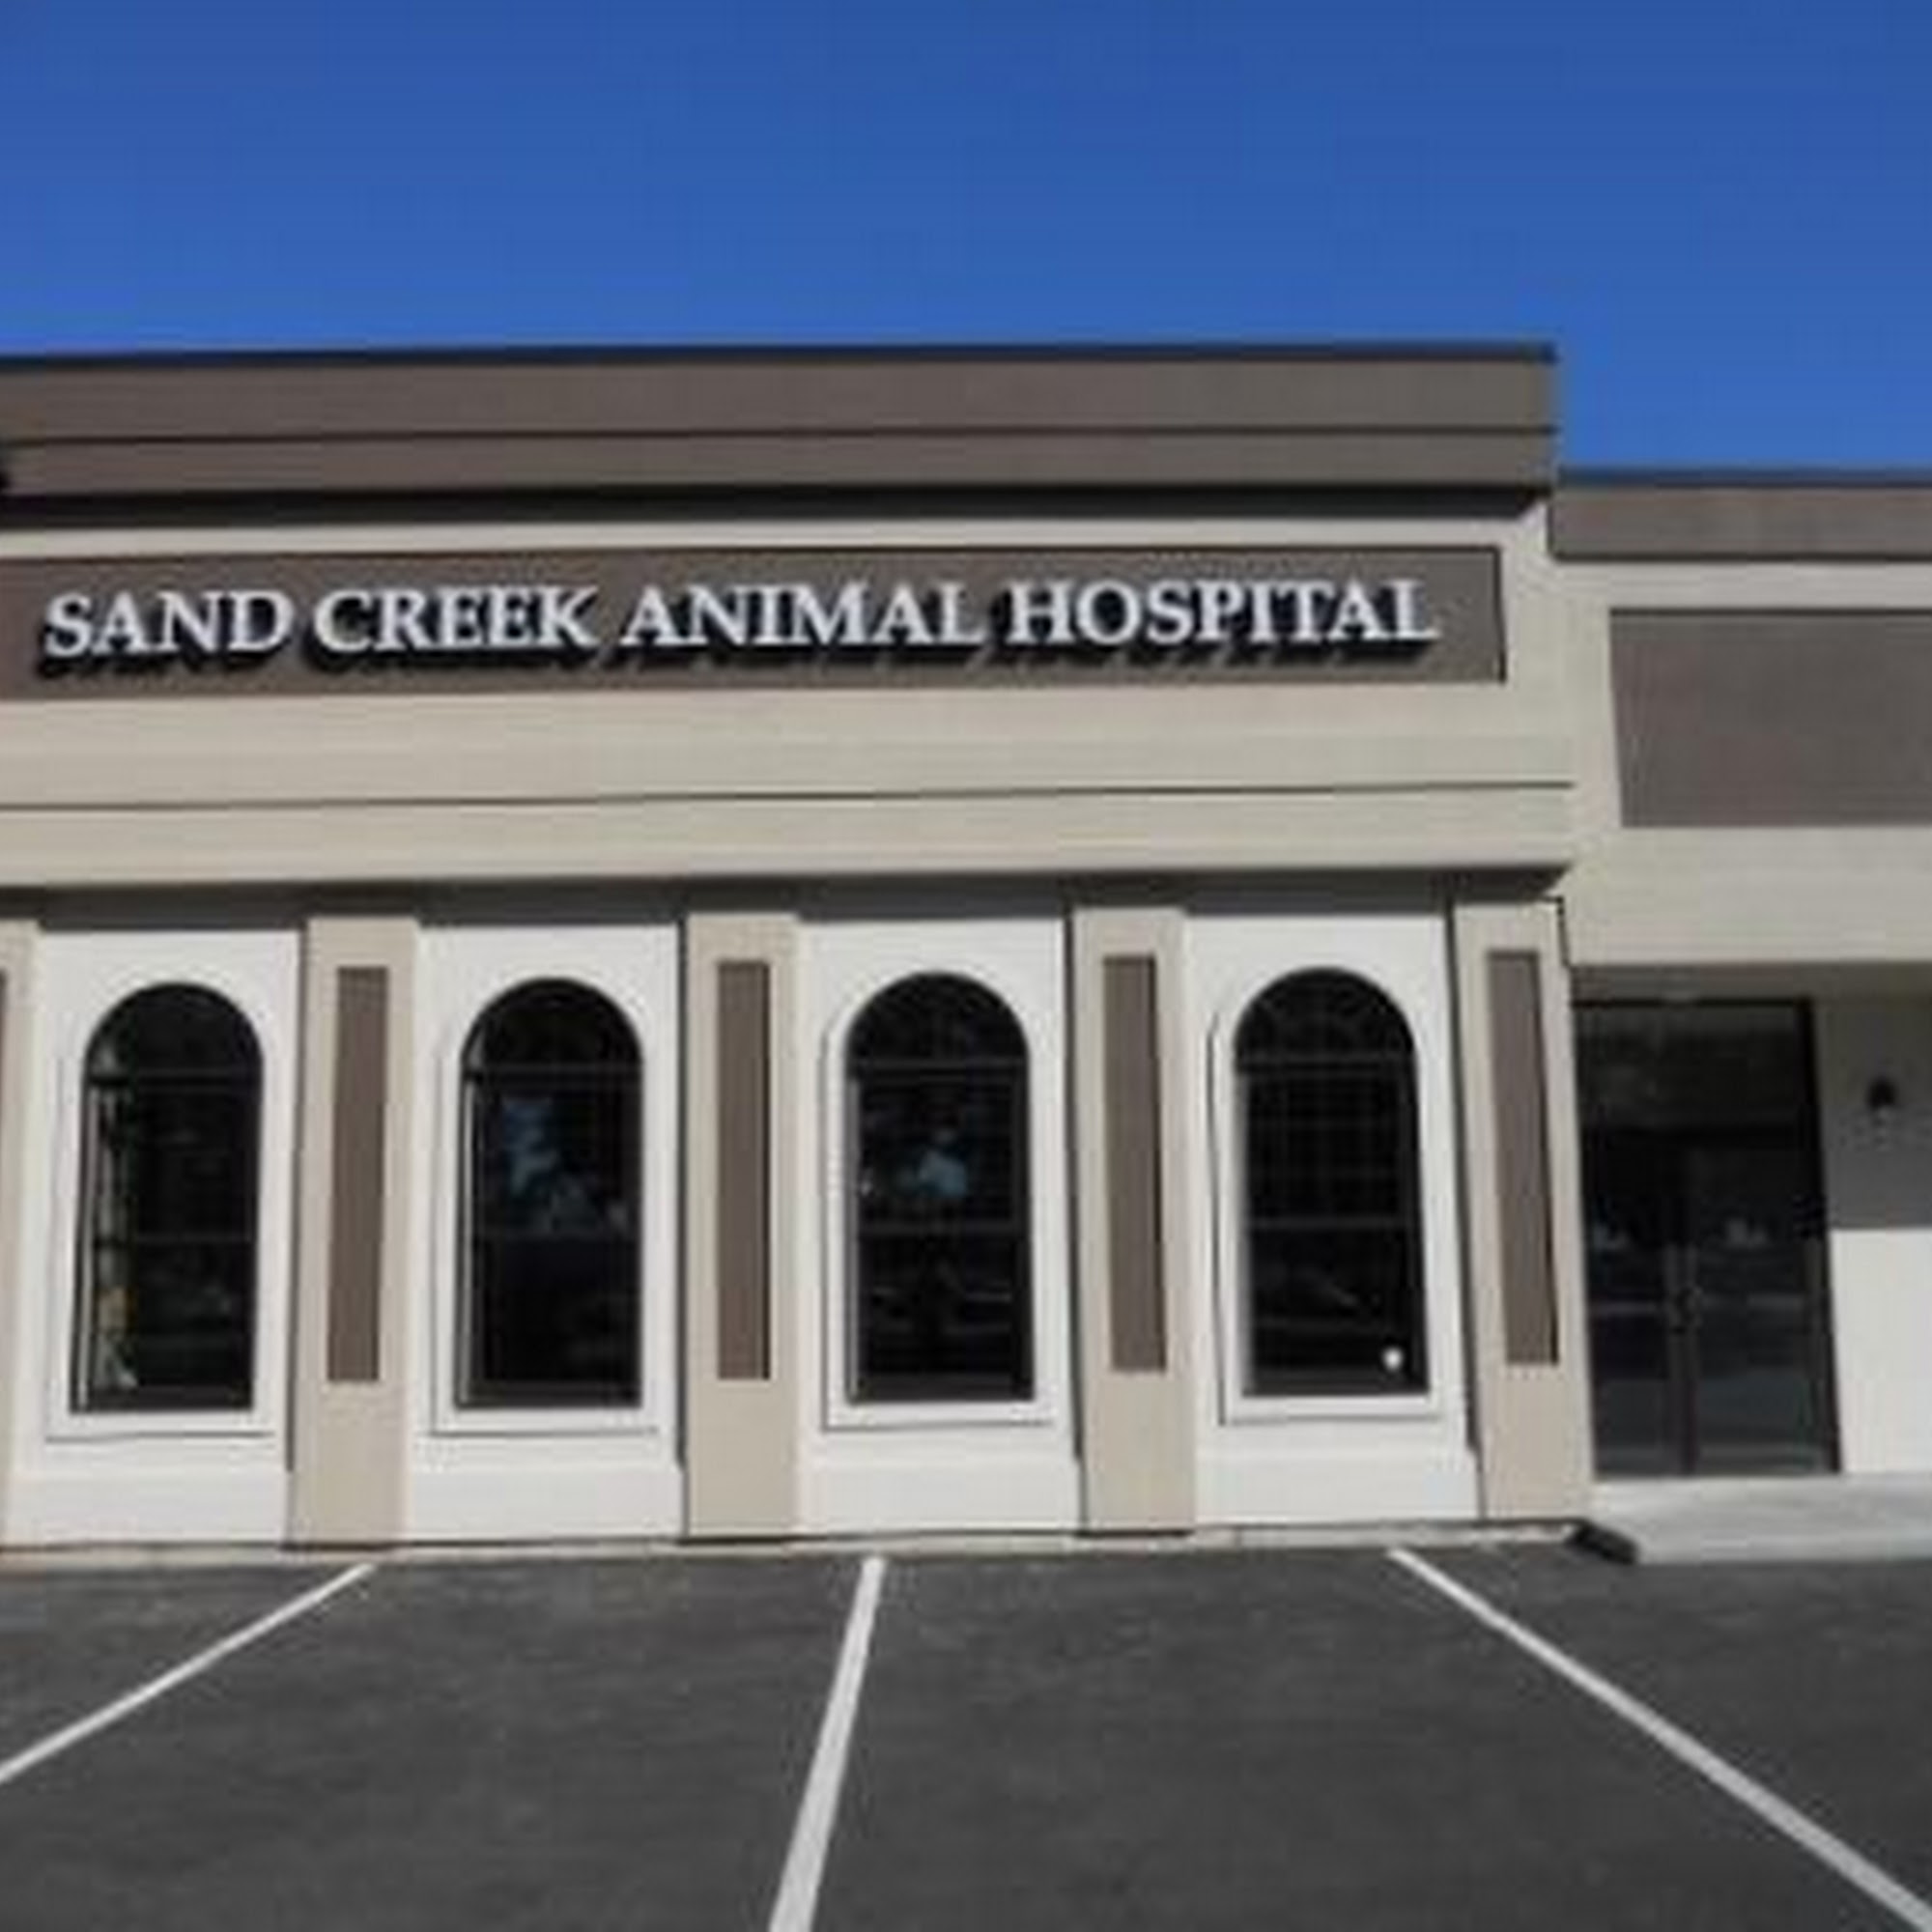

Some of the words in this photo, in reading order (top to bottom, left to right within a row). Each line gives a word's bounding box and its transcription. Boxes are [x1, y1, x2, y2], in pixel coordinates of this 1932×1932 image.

[43, 589, 293, 658] SAND
[312, 584, 600, 652] CREEK
[619, 581, 983, 647] ANIMAL
[1007, 578, 1440, 645] HOSPITAL
